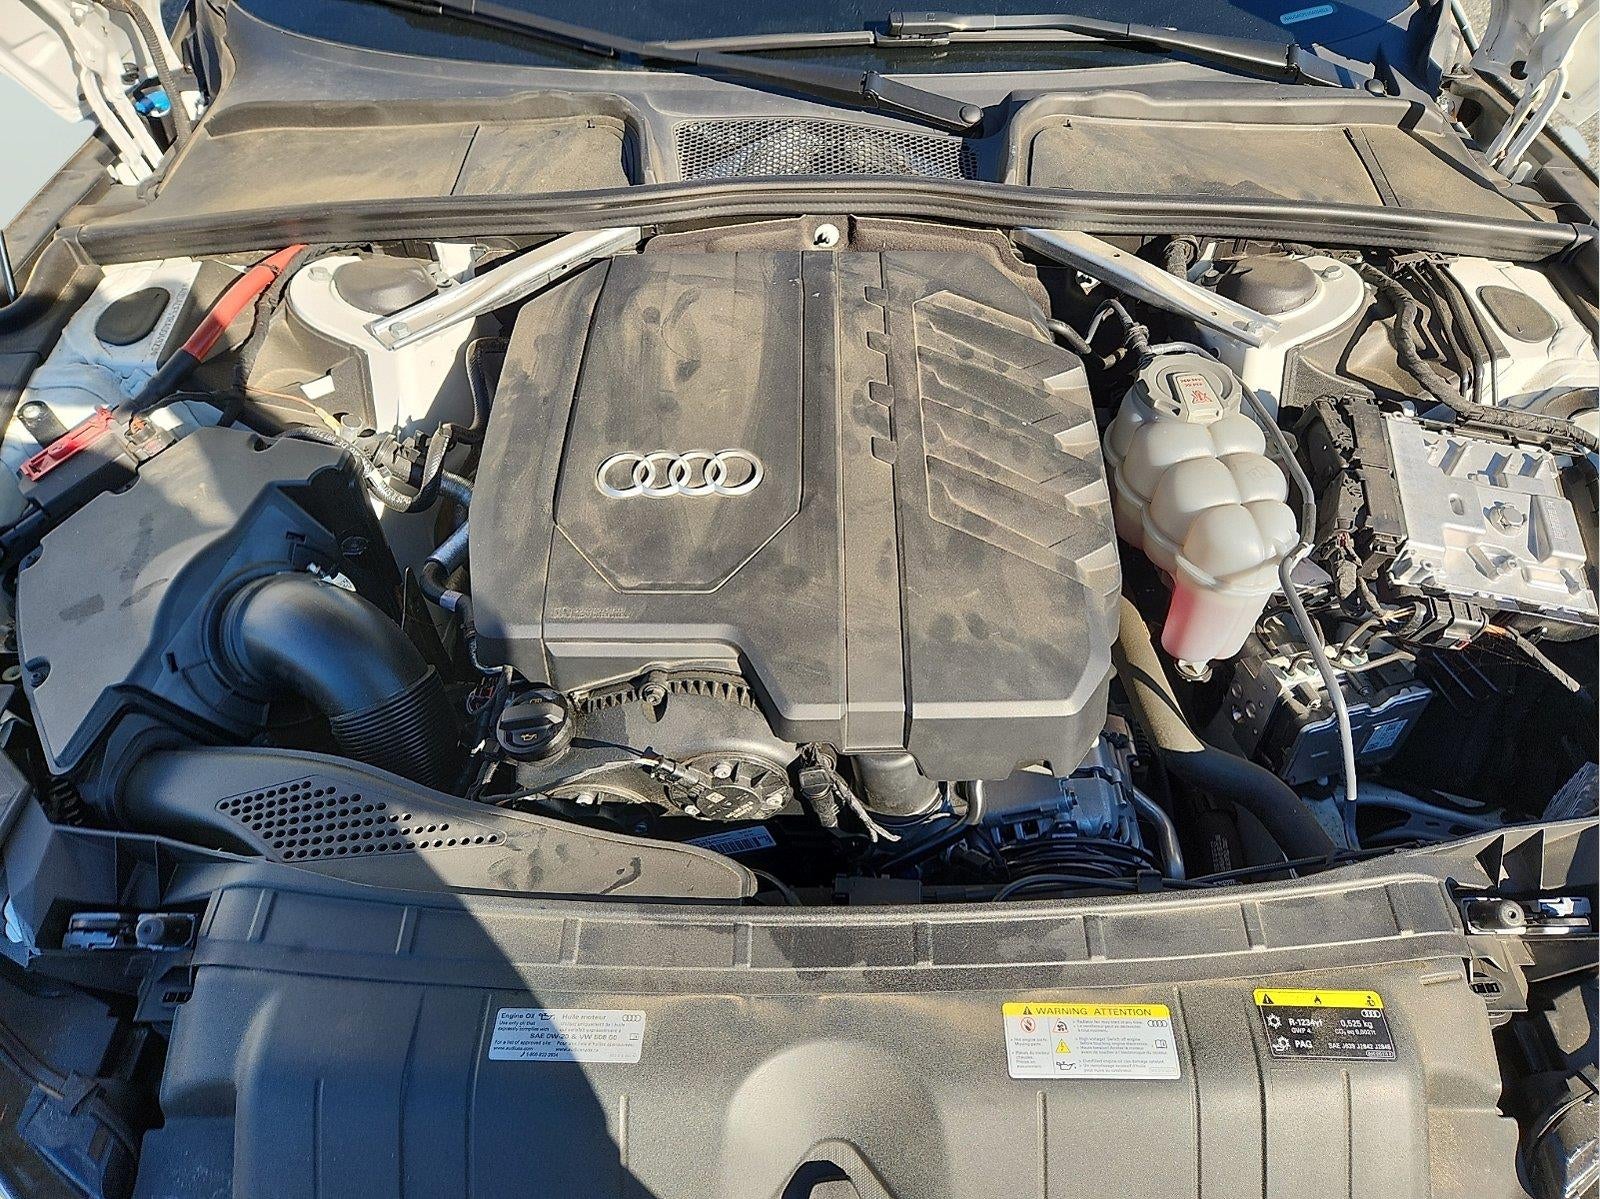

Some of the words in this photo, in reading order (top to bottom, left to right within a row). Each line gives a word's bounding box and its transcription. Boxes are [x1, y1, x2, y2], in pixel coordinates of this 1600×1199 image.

[501, 1012, 524, 1020] Engine
[1035, 1007, 1088, 1015] WARNING
[1093, 1008, 1152, 1016] ATTENTION
[1340, 1020, 1361, 1028] 0,525
[1363, 1020, 1374, 1029] kg
[1294, 1040, 1314, 1049] PAG
